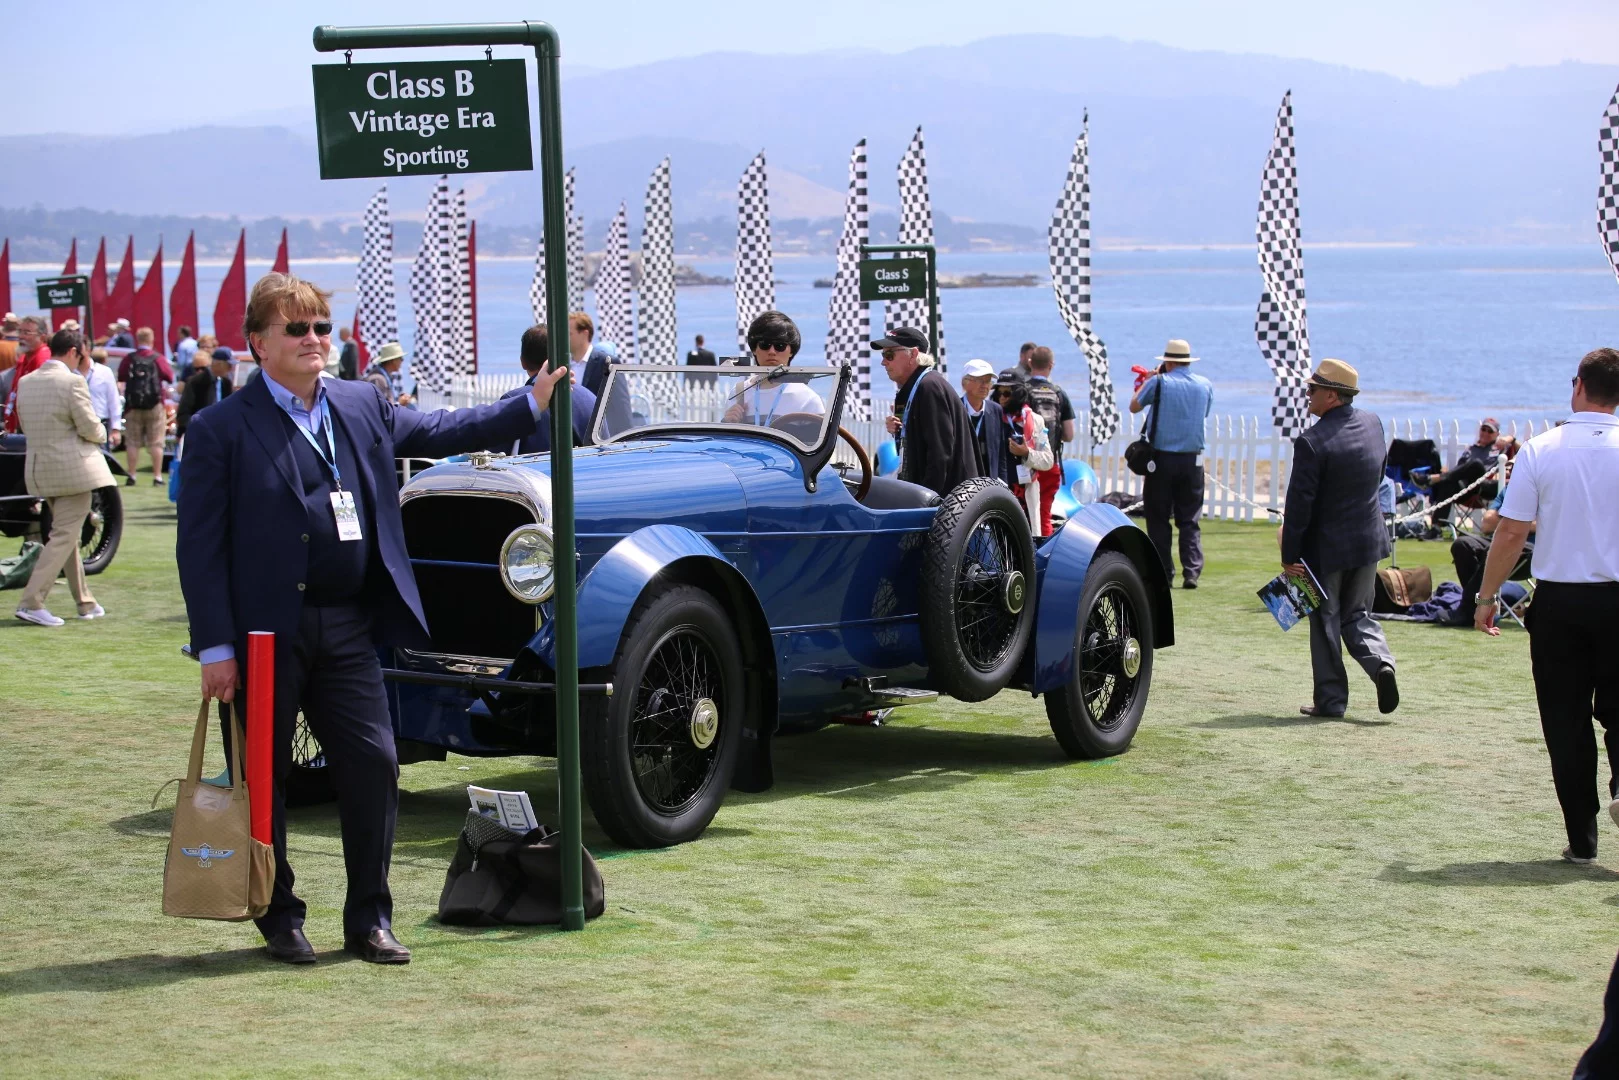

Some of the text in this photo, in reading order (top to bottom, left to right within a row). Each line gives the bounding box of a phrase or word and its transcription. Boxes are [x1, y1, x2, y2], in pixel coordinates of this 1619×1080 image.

[366, 69, 475, 100] Class B
[349, 107, 497, 138] Vintage Era
[383, 145, 470, 172] Sporting
[875, 268, 909, 280] Class S
[878, 283, 909, 293] Scarab
